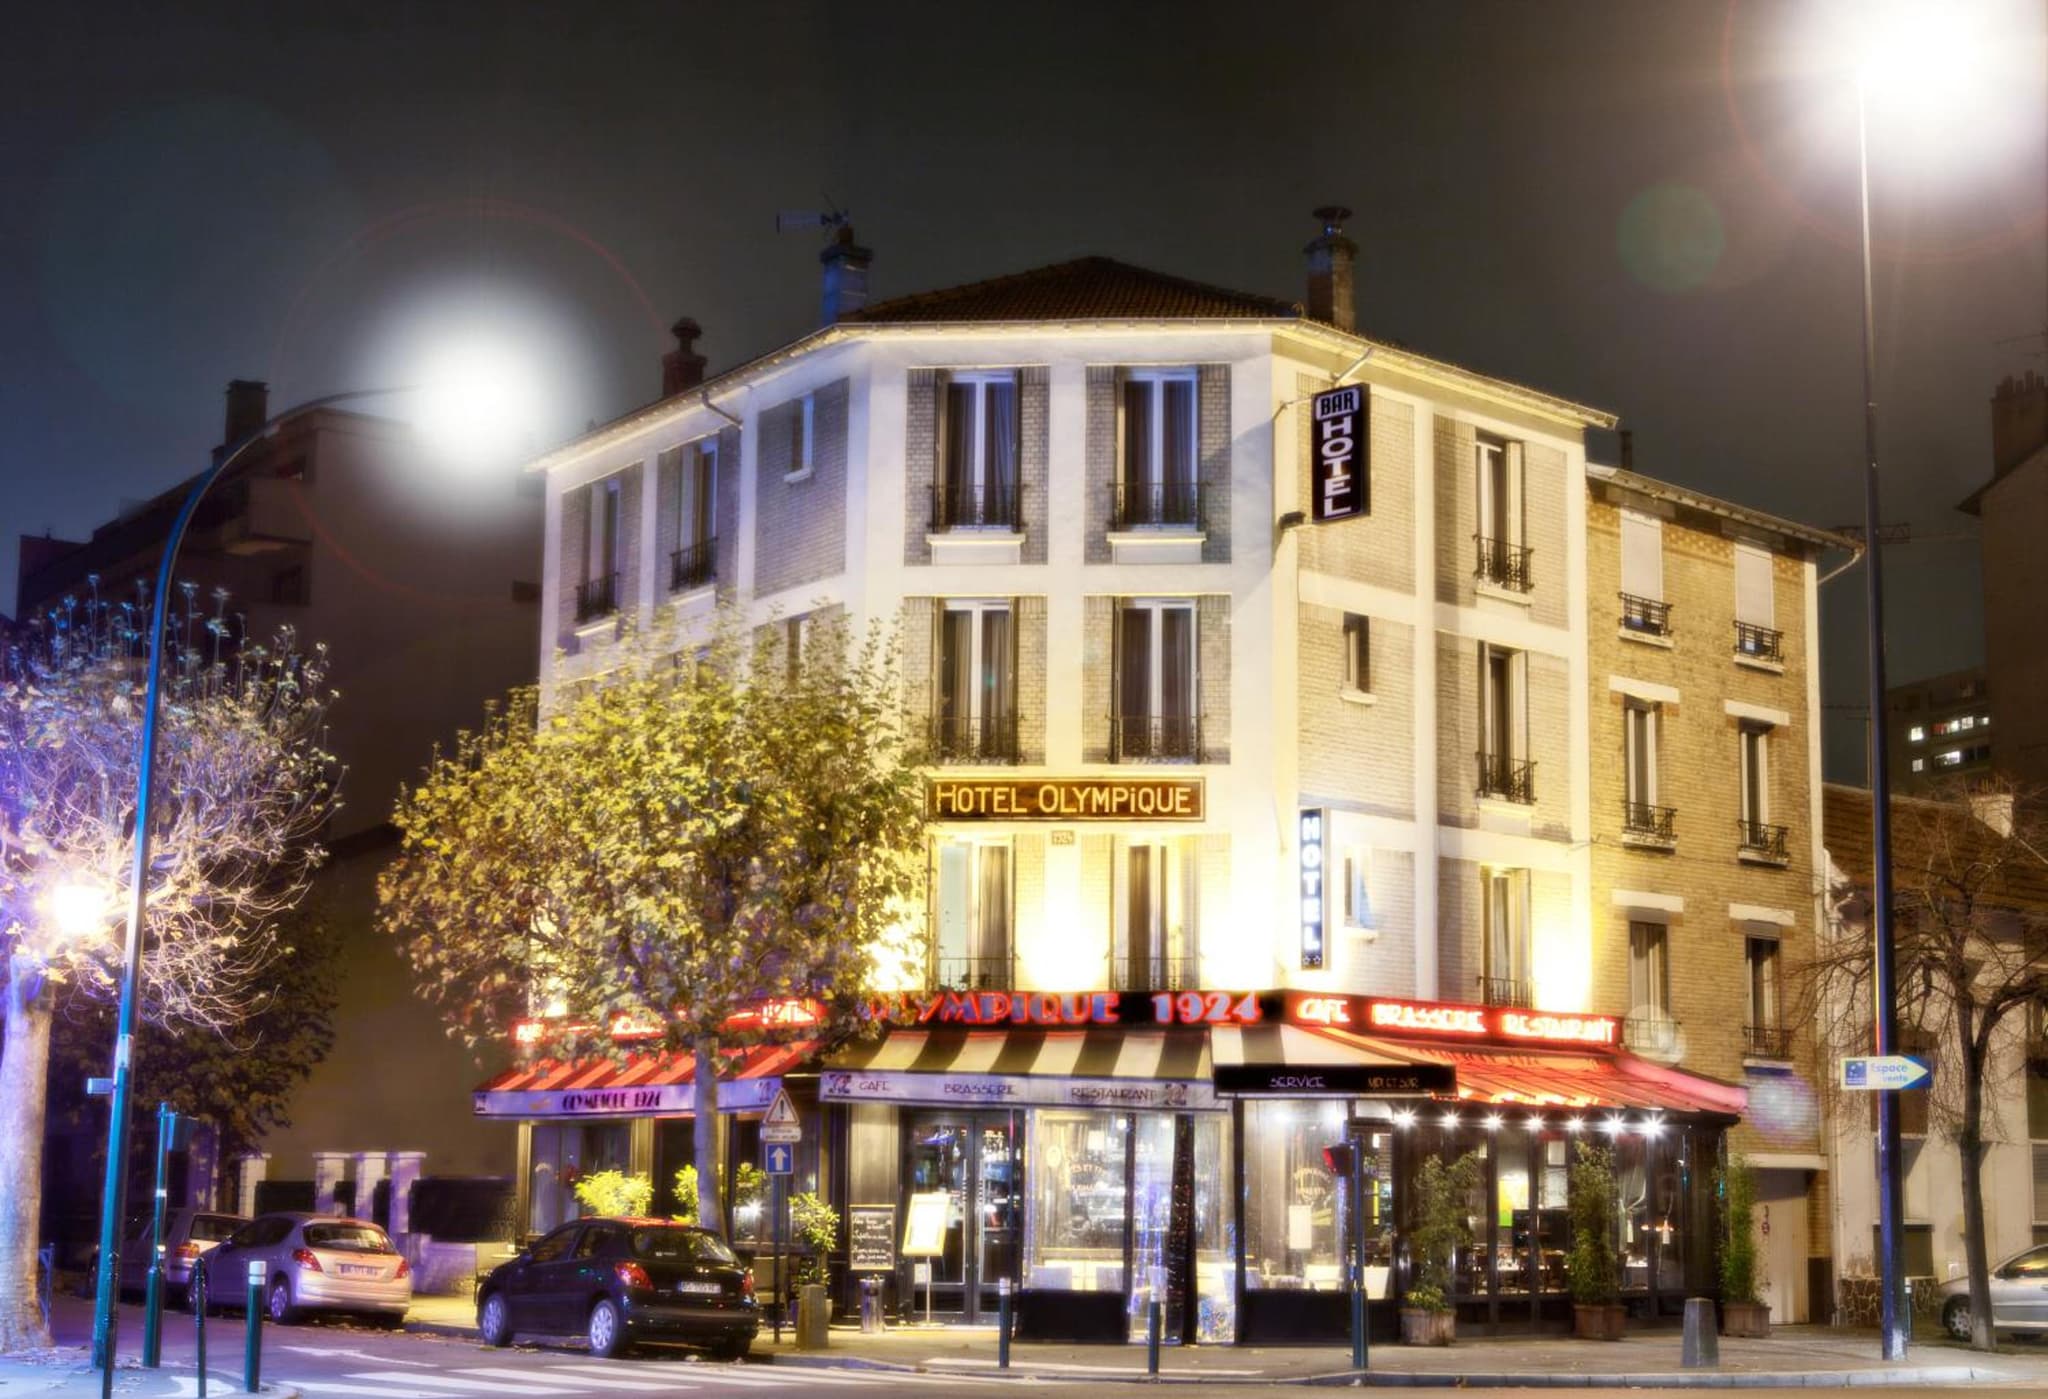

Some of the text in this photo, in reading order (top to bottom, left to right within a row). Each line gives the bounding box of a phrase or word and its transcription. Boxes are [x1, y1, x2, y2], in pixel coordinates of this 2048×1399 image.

[1320, 391, 1354, 416] BAR
[1321, 415, 1353, 517] HOTEL
[936, 784, 1028, 813] HOTEL
[1302, 816, 1321, 951] HOTEL
[1151, 988, 1263, 1024] 1924
[1296, 998, 1616, 1044] CAFE BRASSERIE RESTAURANT
[859, 1079, 1155, 1101] CAFE BRASSERIE RESTAURANT
[1269, 1076, 1326, 1089] SERVICE
